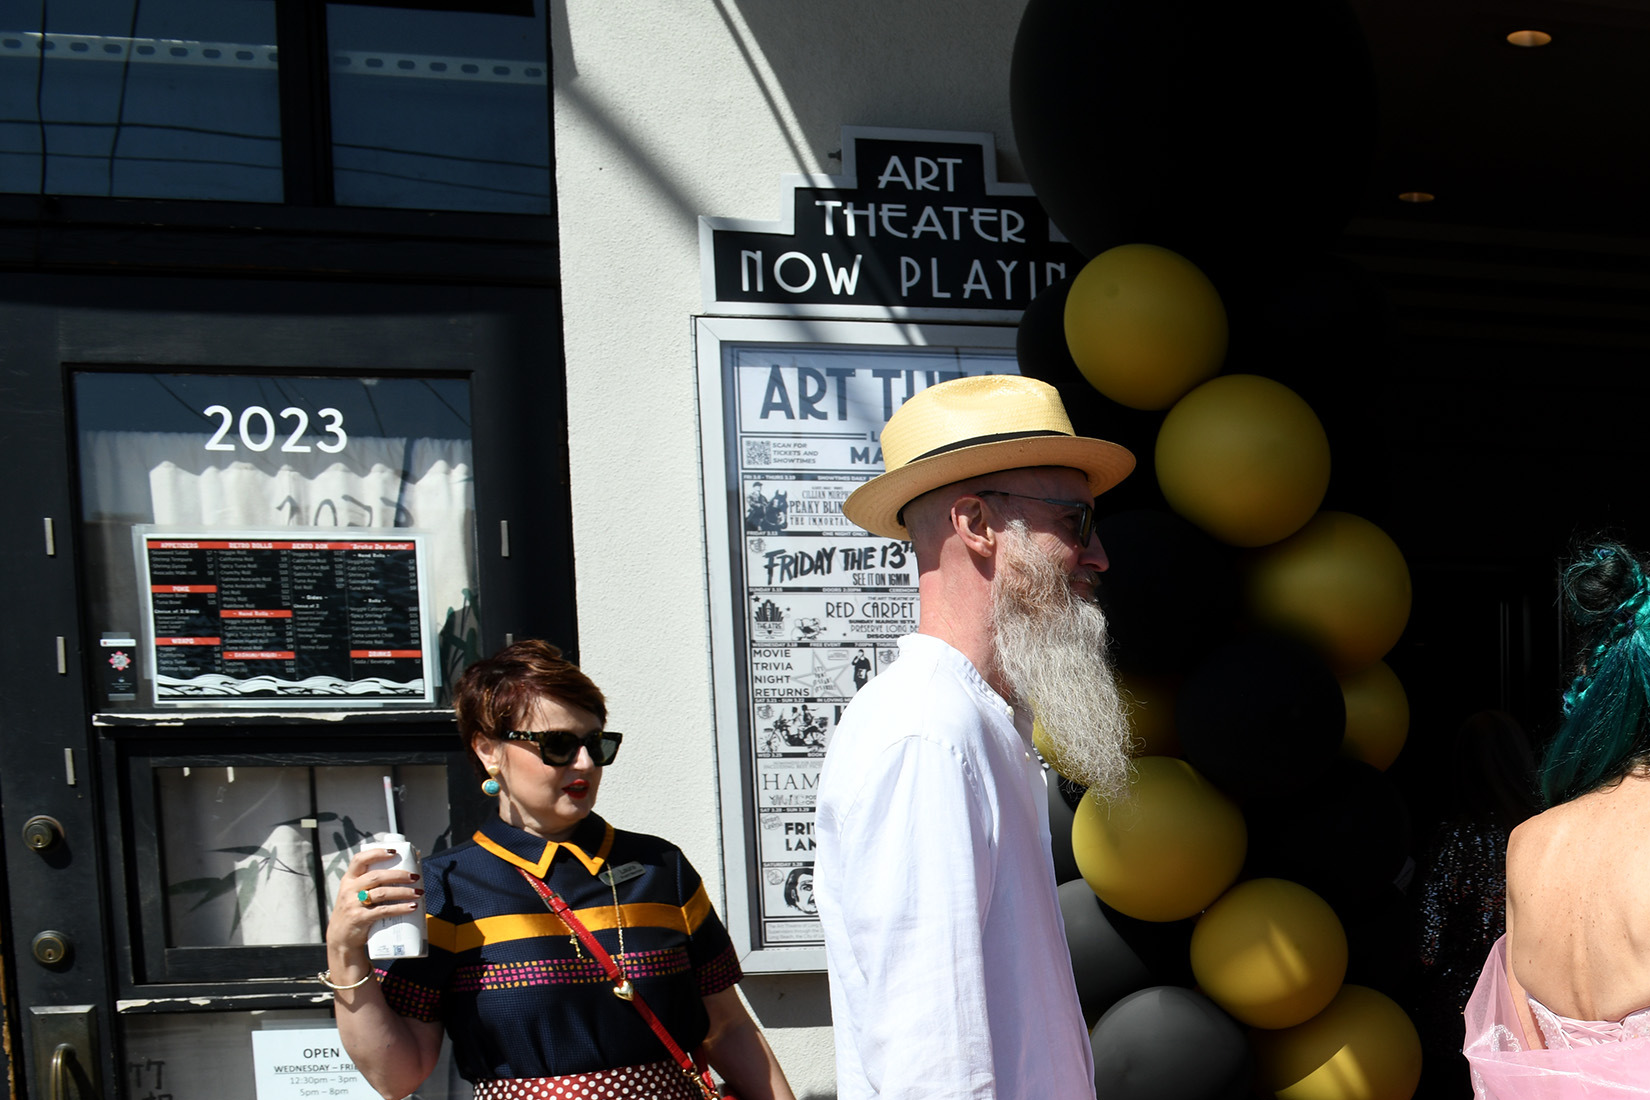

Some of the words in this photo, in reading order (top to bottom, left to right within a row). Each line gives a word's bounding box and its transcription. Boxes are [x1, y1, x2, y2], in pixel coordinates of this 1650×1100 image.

[878, 155, 963, 192] ART
[815, 200, 1026, 243] THEATER
[741, 250, 862, 296] NOW
[901, 257, 1066, 300] PLAYIN
[760, 365, 855, 420] ART
[203, 405, 348, 453] 2023
[802, 490, 826, 499] CILLIAN
[828, 490, 849, 499] MURPH
[790, 500, 820, 514] PEAKY
[823, 500, 843, 514] BLIN
[790, 517, 804, 526] THE
[808, 517, 849, 526] IMMORTAL
[762, 546, 837, 585] FRIDAY
[839, 547, 877, 571] THE
[853, 573, 867, 586] SEE
[867, 573, 875, 586] IT
[875, 573, 886, 586] ON
[888, 573, 911, 586] 16MM
[826, 602, 855, 618] RED
[861, 602, 914, 618] CARPET
[757, 622, 782, 630] THEATRE
[850, 625, 883, 633] PRESERVE
[886, 625, 907, 633] LONG
[753, 649, 791, 658] MOVIE
[754, 662, 793, 671] TRIVIA
[754, 675, 791, 684] NIGHT
[755, 688, 810, 697] RETURNS
[762, 773, 821, 791] HAM
[784, 822, 815, 836] FRI
[785, 838, 817, 851] LAN
[303, 1048, 340, 1059] OPEN
[274, 1064, 330, 1073] WEDNESDAY
[340, 1063, 358, 1071] FRI
[290, 1076, 328, 1085] 12:30pm
[338, 1075, 358, 1084] 3pm
[300, 1088, 320, 1097] 5pm
[329, 1087, 349, 1096] 8pm
